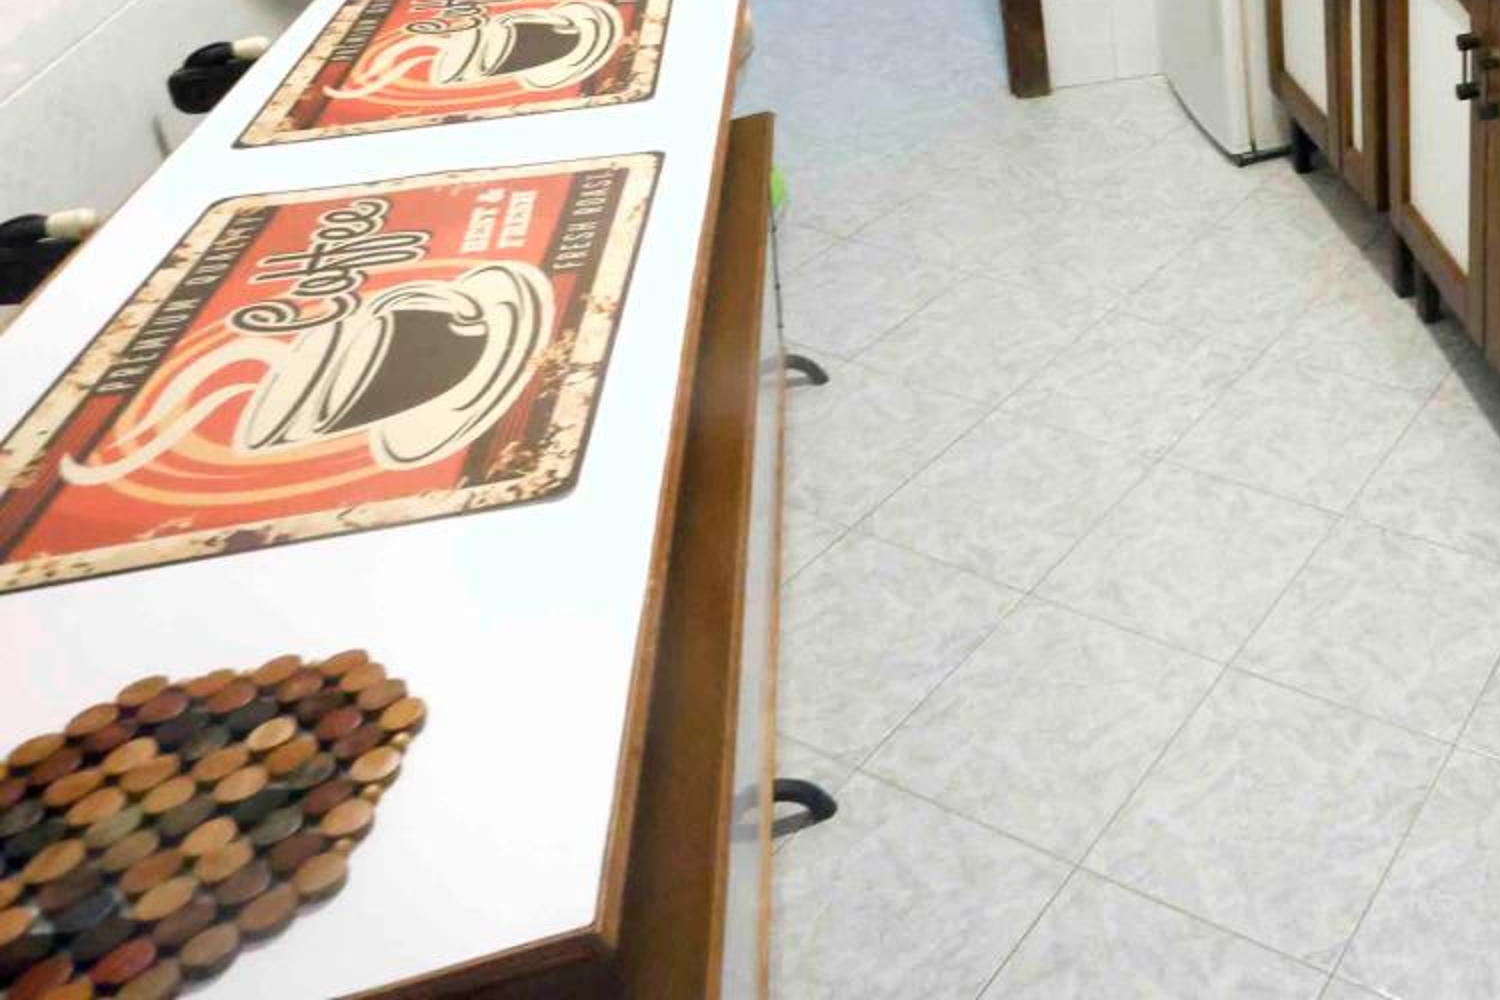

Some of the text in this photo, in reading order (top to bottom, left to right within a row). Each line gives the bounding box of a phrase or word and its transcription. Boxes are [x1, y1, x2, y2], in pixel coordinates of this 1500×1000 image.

[224, 196, 431, 334] Coffee
[552, 172, 614, 269] FRESH ROAST
[96, 299, 200, 393] PREMIUM
